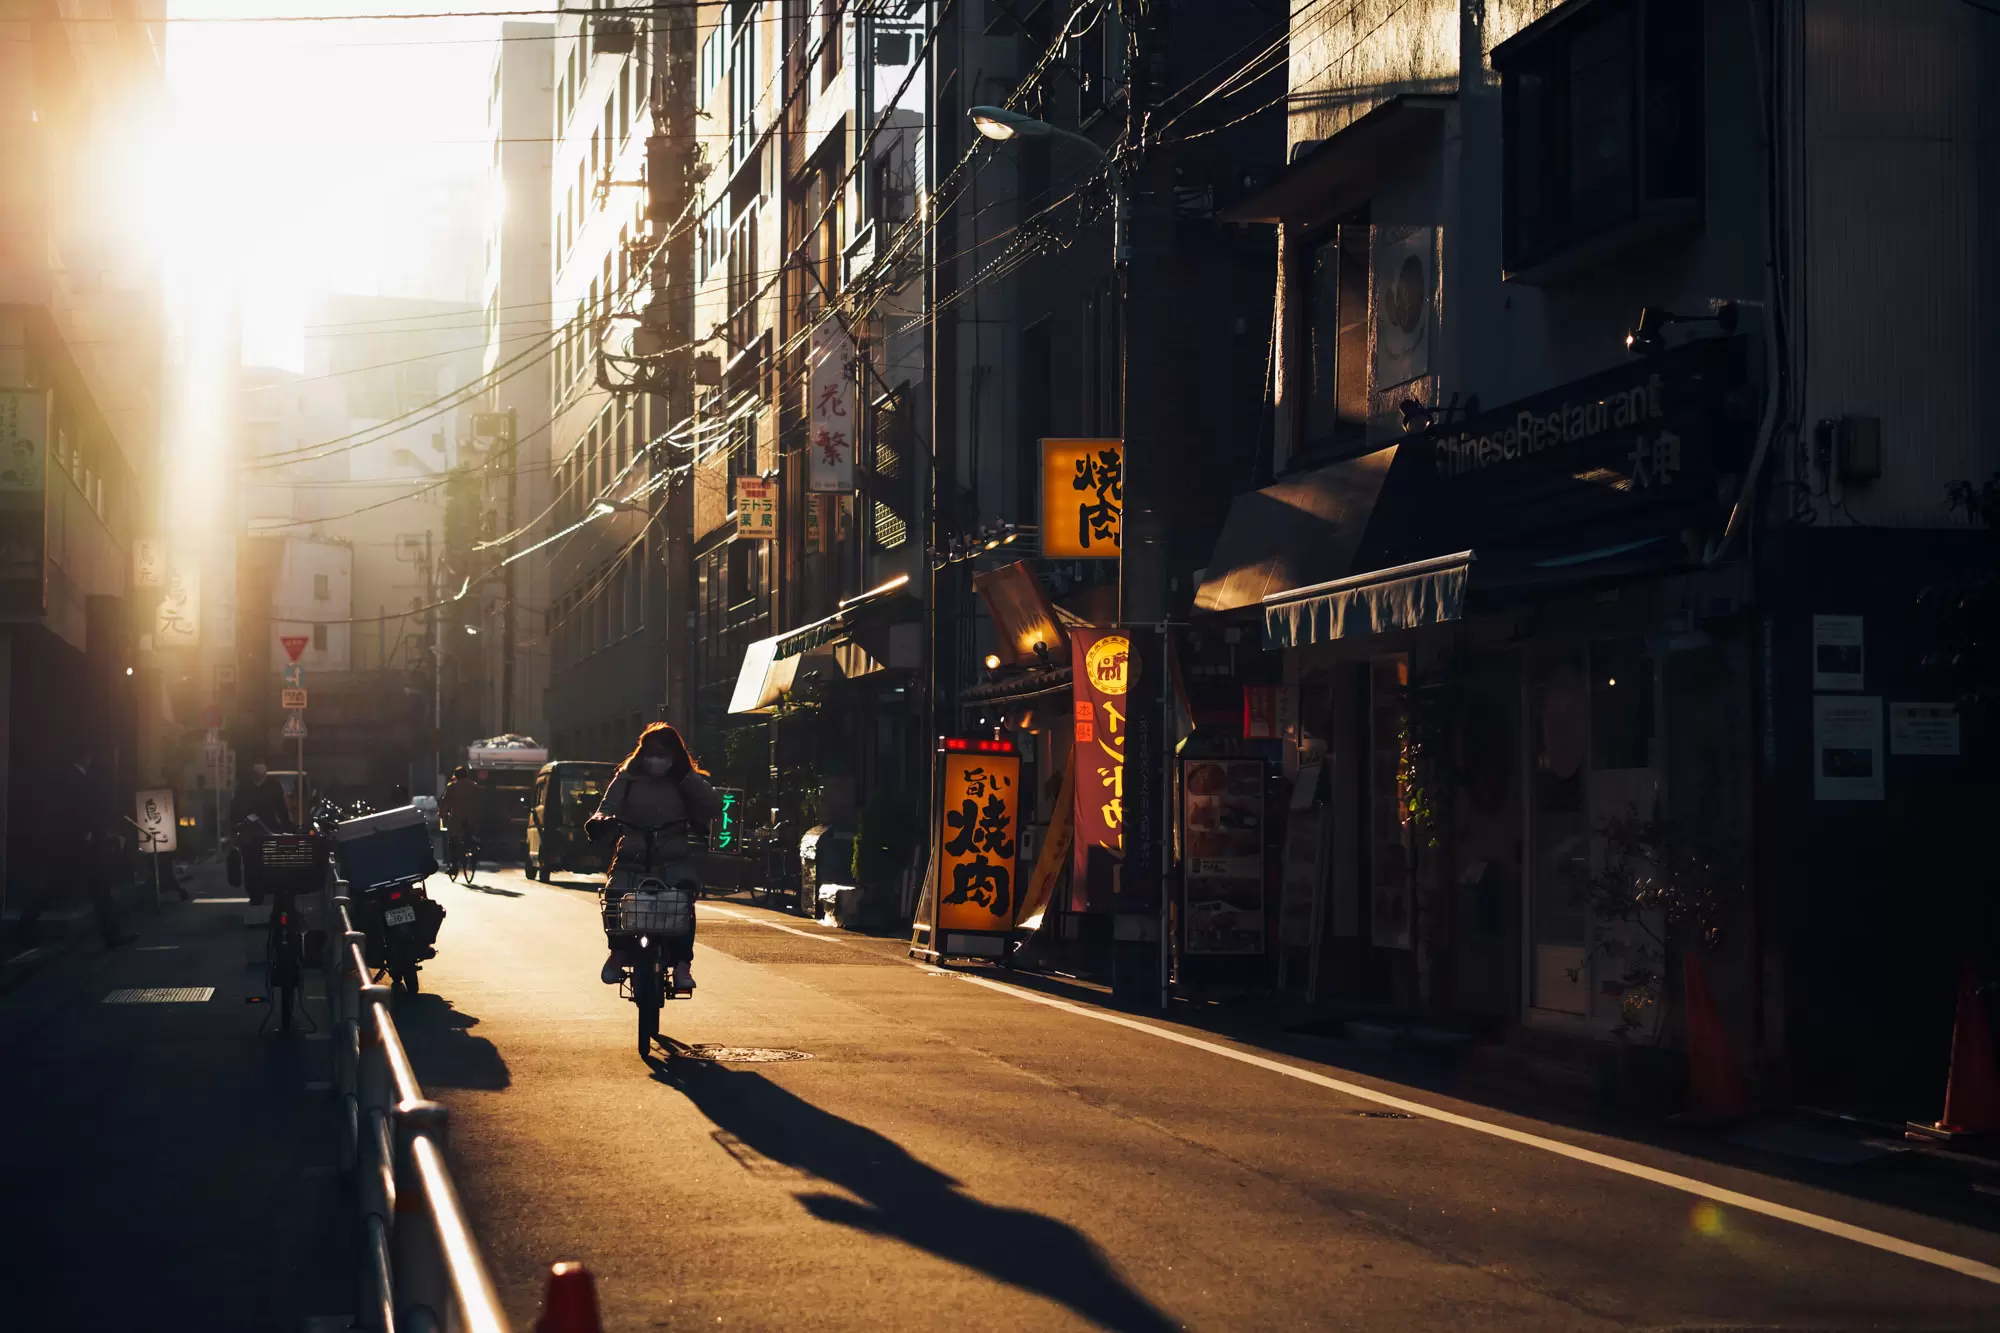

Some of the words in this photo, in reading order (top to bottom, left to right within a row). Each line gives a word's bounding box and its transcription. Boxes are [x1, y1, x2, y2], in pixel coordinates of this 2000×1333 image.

[815, 383, 850, 467] 花繁
[740, 499, 772, 512] テトラ
[740, 514, 772, 527] 薬局
[1073, 447, 1122, 549] 焼肉
[963, 767, 1011, 797] 旨い
[718, 794, 736, 849] テトラ
[942, 793, 1015, 918] 焼肉
